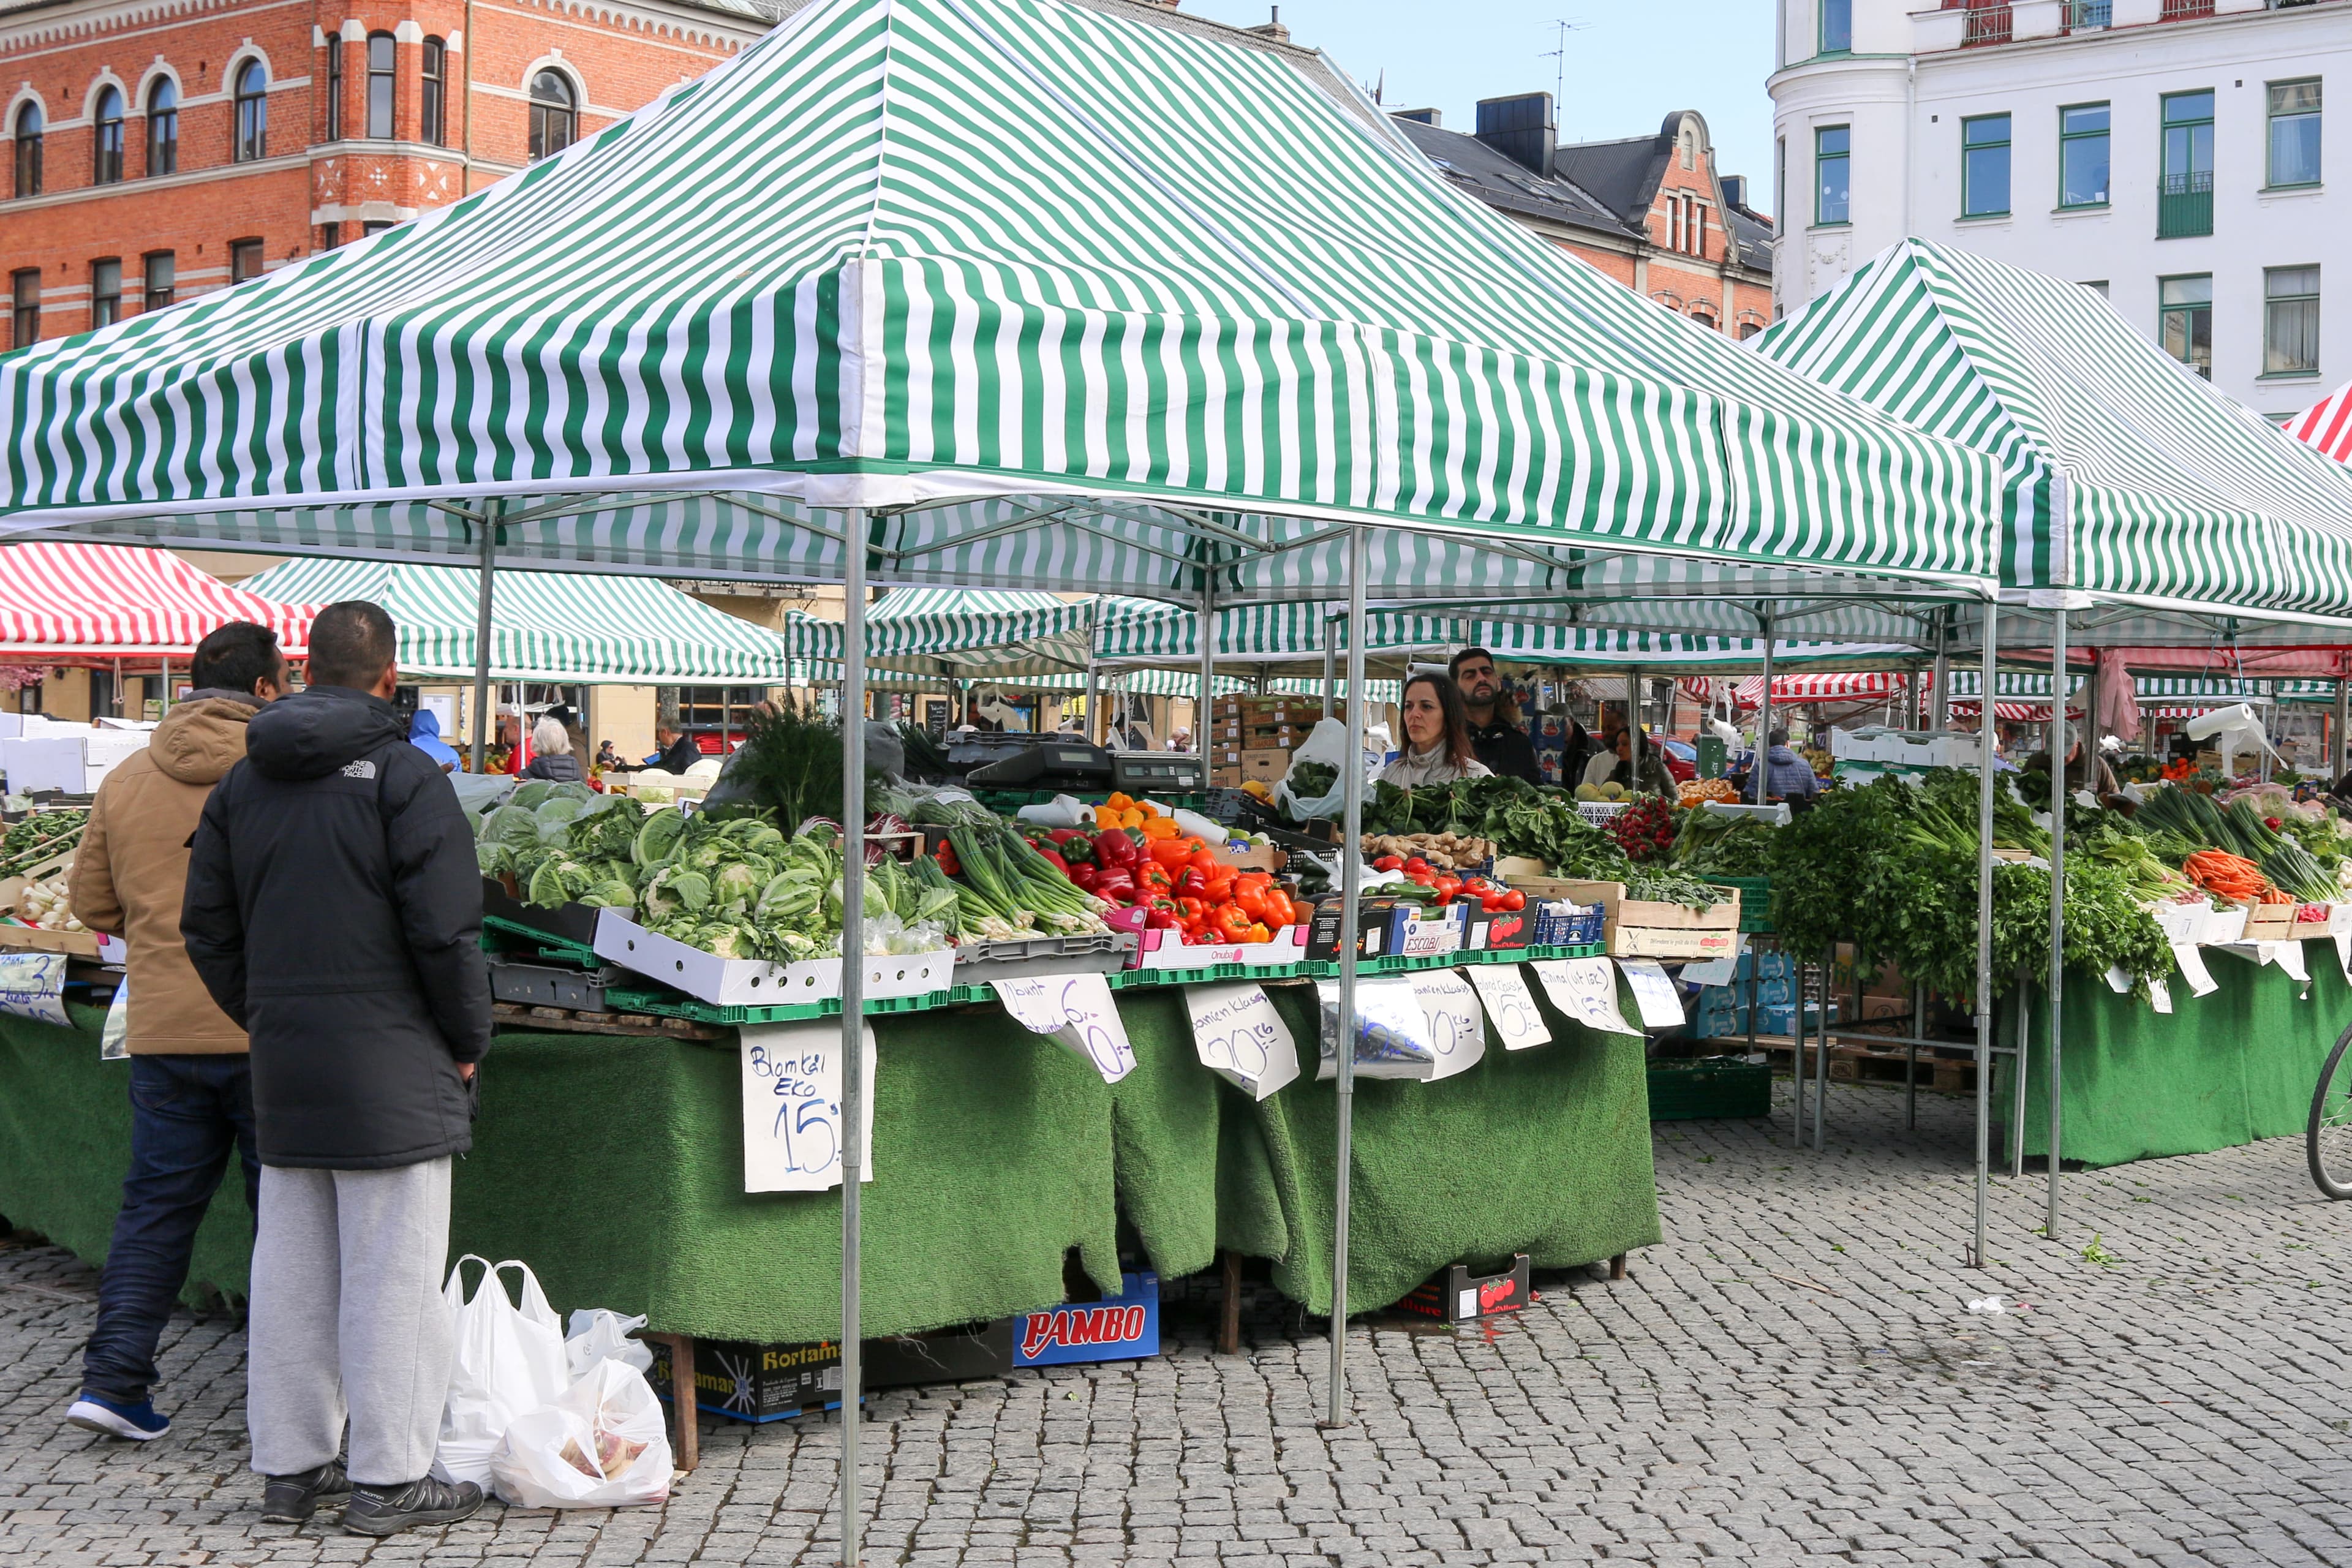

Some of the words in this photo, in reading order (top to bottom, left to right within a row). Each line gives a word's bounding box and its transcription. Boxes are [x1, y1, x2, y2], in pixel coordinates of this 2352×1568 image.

[1405, 937, 1440, 951] ESCOBI
[1212, 950, 1233, 960] Onuba
[1539, 967, 1567, 984] China
[1021, 1305, 1146, 1359] PAMBO
